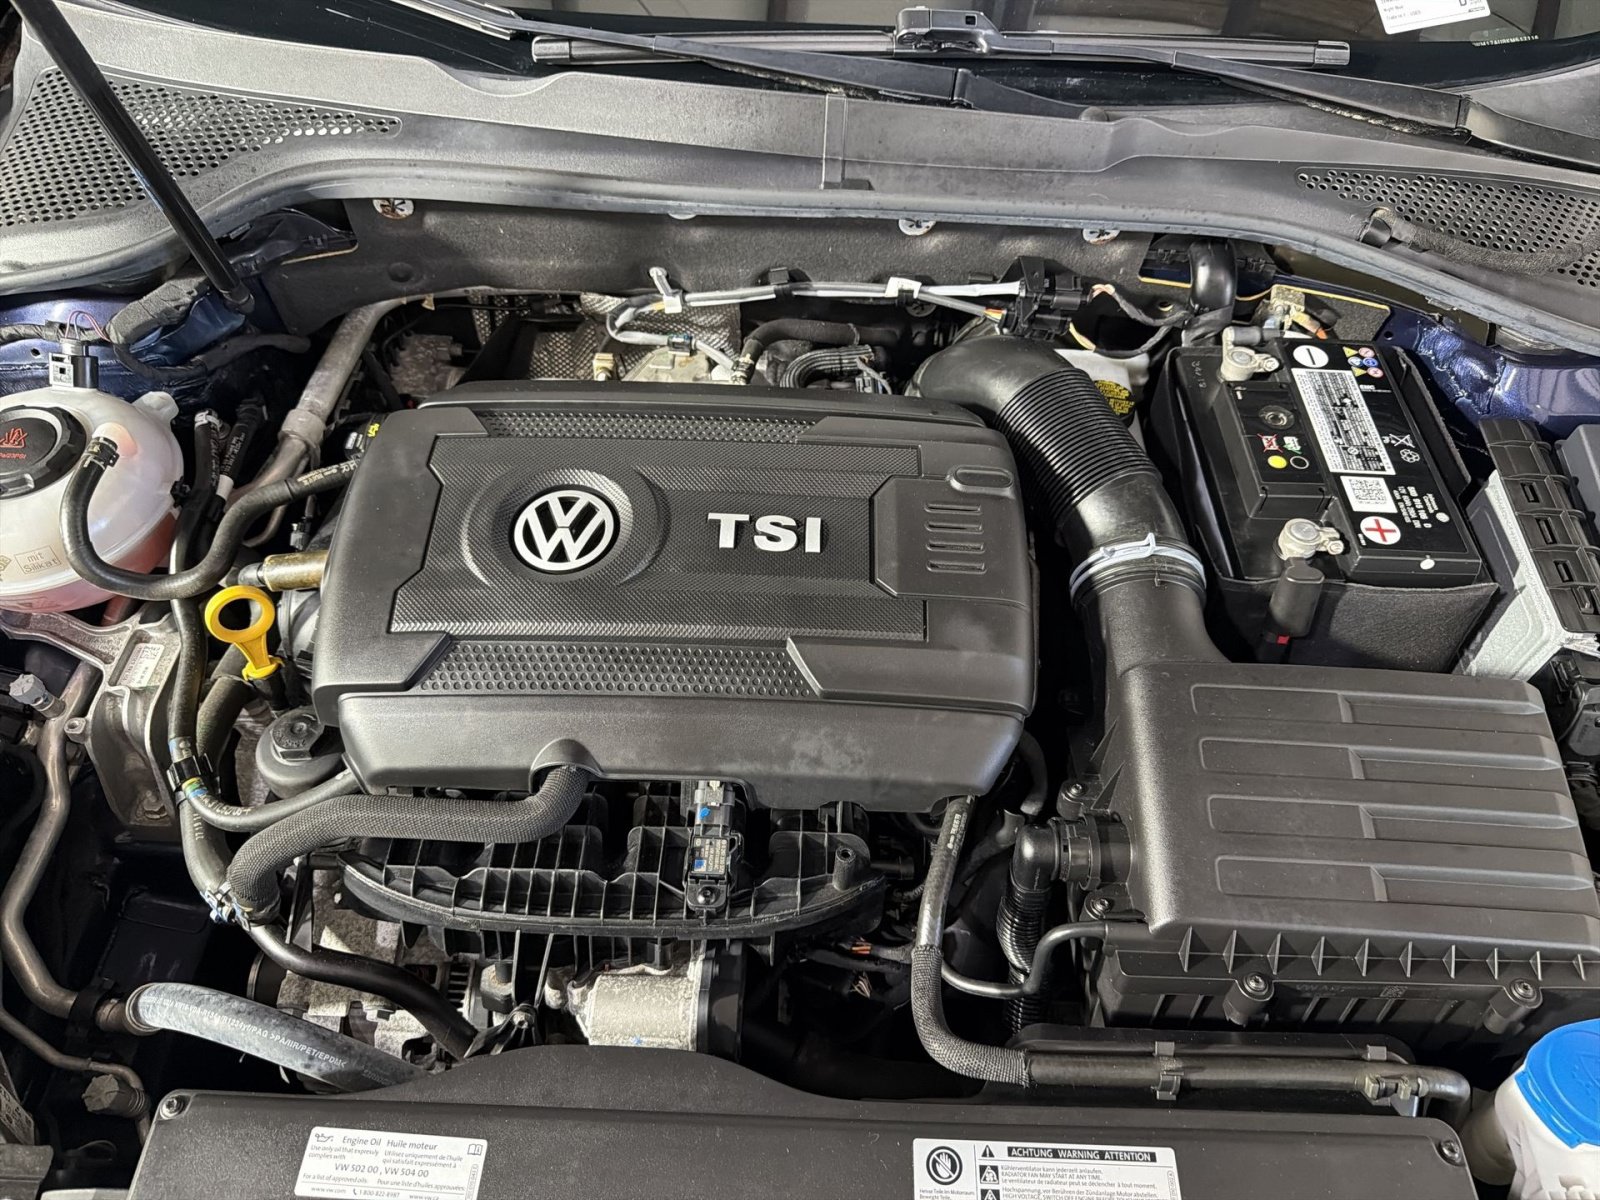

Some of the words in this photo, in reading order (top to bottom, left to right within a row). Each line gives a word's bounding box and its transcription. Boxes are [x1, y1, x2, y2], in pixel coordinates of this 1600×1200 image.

[707, 512, 822, 553] TSI
[27, 552, 44, 562] mit
[23, 559, 58, 572] Silikat
[342, 1136, 369, 1146] Engine
[370, 1137, 382, 1146] Oil
[386, 1139, 407, 1149] Huile
[408, 1141, 438, 1150] moteur
[405, 1152, 438, 1160] uniquement
[1011, 1148, 1053, 1158] ACHTUNG
[1057, 1149, 1100, 1160] WARNING
[1104, 1151, 1151, 1162] ATTENTION
[335, 1163, 350, 1171] VW
[351, 1164, 366, 1173] 502
[384, 1166, 399, 1175] VW
[400, 1167, 416, 1176] 504
[417, 1169, 429, 1178] 00
